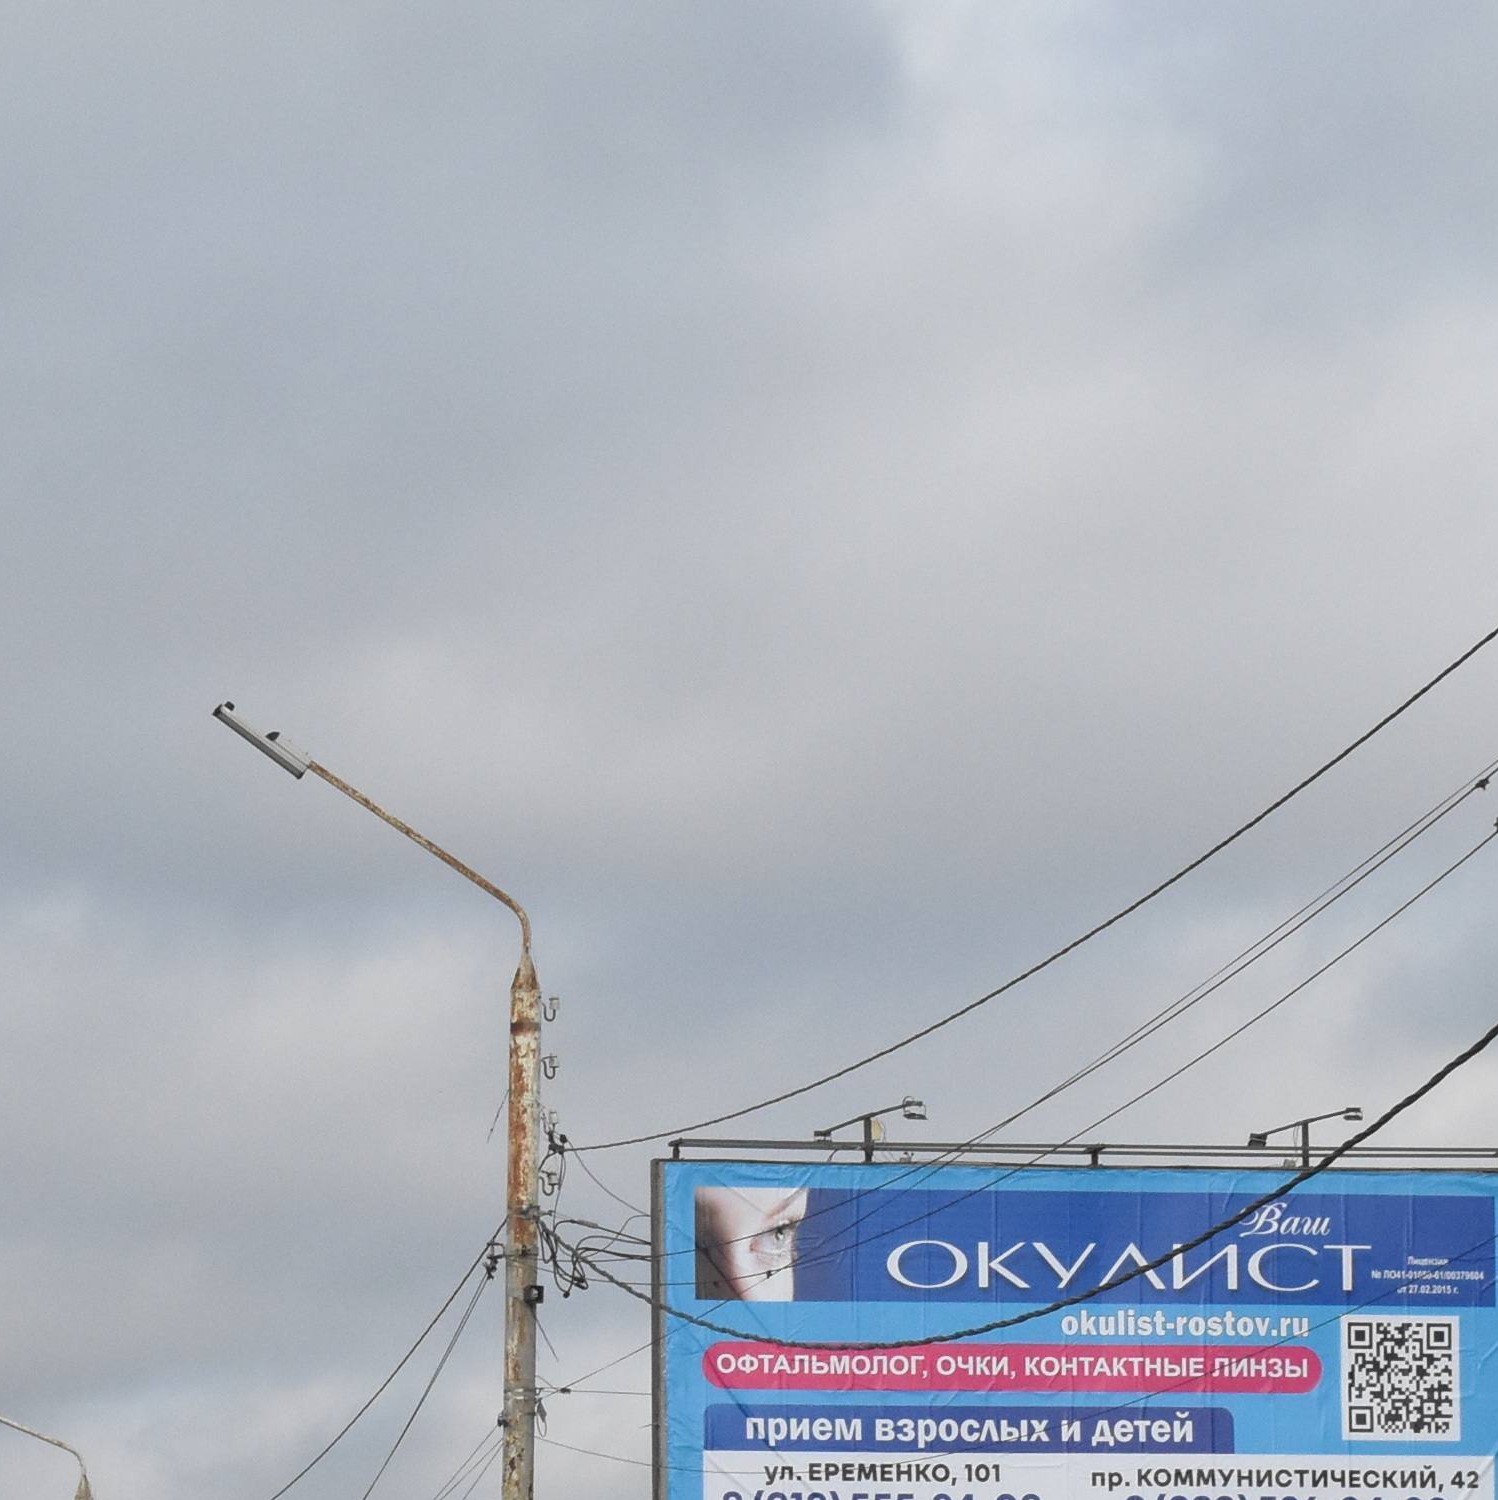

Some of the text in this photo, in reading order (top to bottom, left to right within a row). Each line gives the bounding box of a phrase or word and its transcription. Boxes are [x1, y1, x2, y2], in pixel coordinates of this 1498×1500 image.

[1240, 1202, 1331, 1237] Ваш
[886, 1239, 1372, 1292] ОКУЛИСТ
[1061, 1308, 1310, 1338] okulist-rostov.ru
[716, 1353, 1308, 1380] ОФТАЛЬМОЛОГ, ОЧКИ, КОНТАКТНЫЕ ЛИНЗЫ
[746, 1411, 1194, 1449] прием взрослых и детей
[764, 1462, 1001, 1486] ул. ЕРЕМЕНКО, 101
[1091, 1465, 1480, 1494] пр. КОММУНИСТИЧЕСКИЙ, 42
